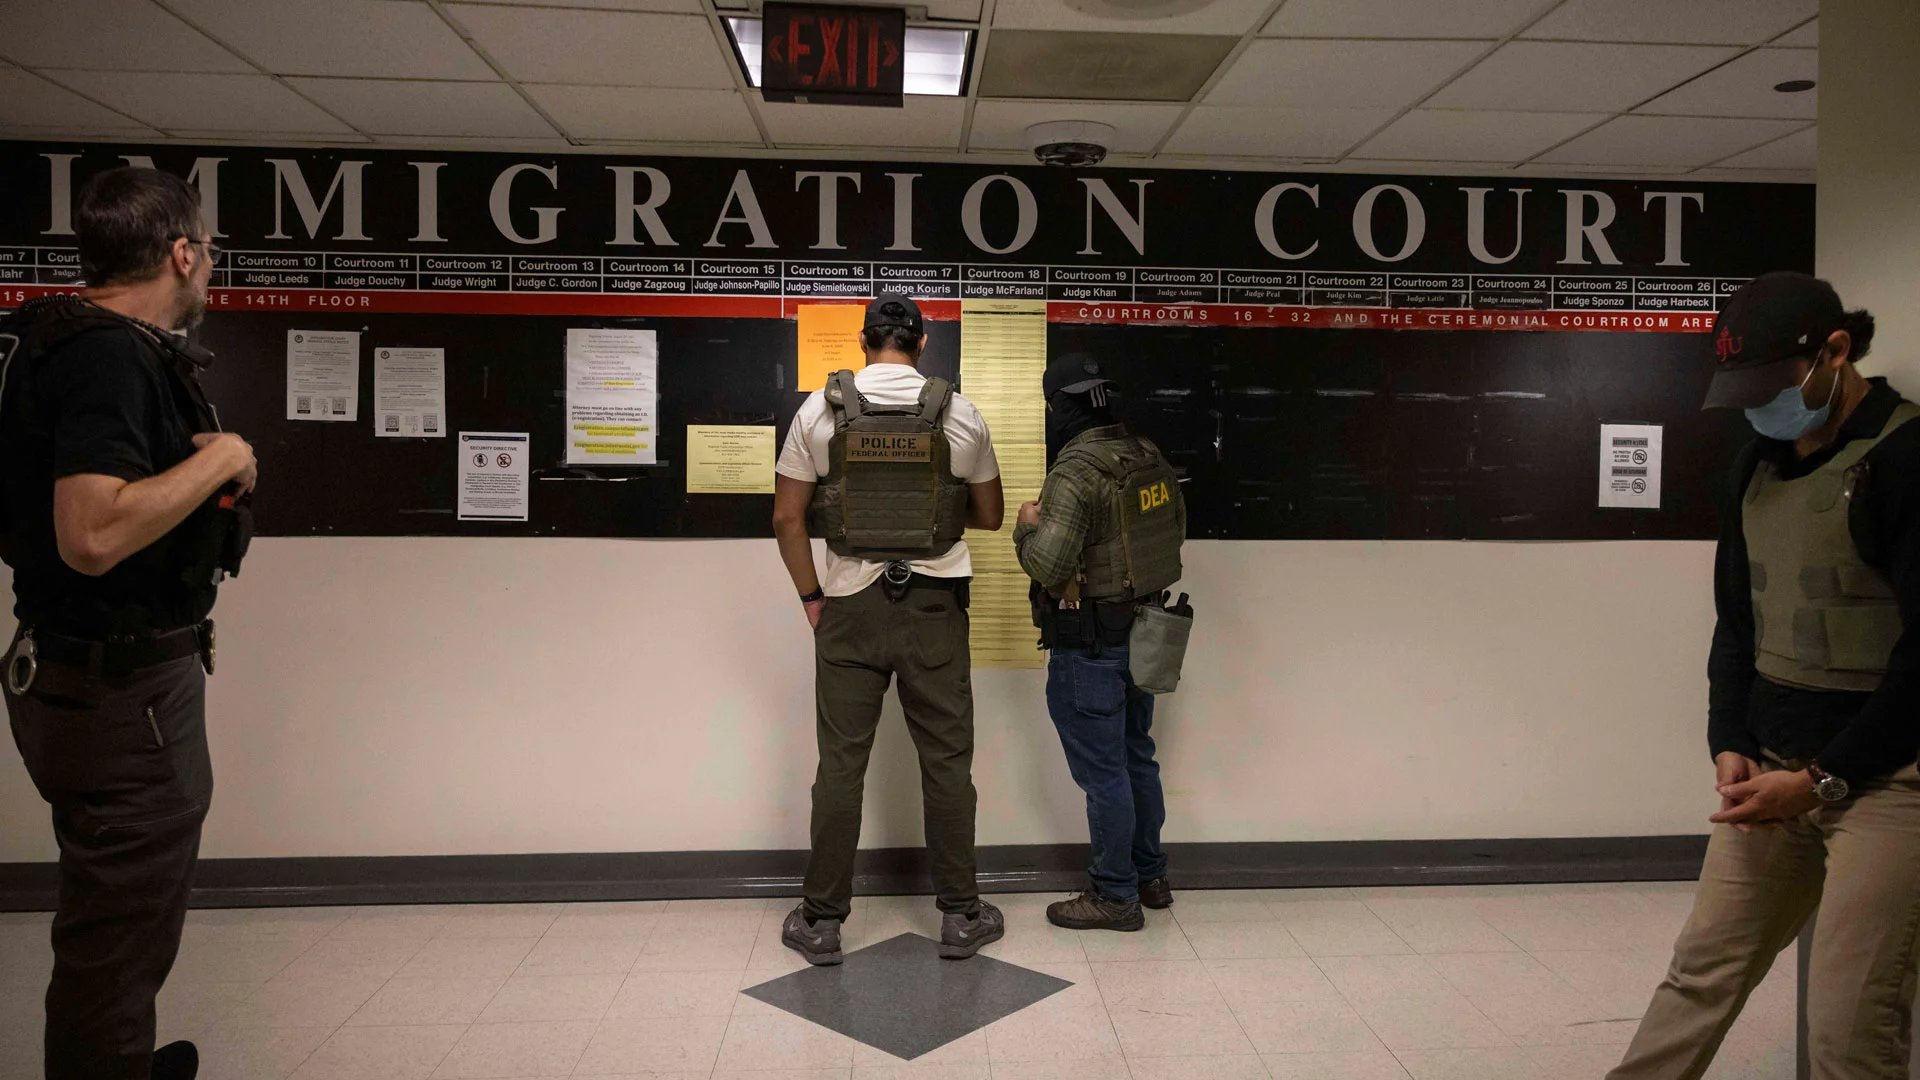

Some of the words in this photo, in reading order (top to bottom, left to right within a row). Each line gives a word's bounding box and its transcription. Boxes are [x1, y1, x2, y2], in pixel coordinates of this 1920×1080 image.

[1253, 182, 1704, 267] COURT
[17, 251, 26, 262] 7
[47, 251, 82, 263] Court
[237, 255, 301, 267] Courtroom
[303, 256, 317, 267] 10
[334, 257, 395, 268] Courtroom
[398, 258, 409, 269] 11
[426, 258, 486, 270] Courtroom
[490, 259, 503, 270] 12
[518, 260, 578, 271] Courtroom
[582, 261, 595, 272] 13
[610, 261, 669, 273] Courtroom
[672, 263, 686, 273] 14
[700, 263, 759, 274] Courtroom
[763, 264, 776, 275] 15
[52, 268, 77, 279] Judge
[790, 265, 848, 276] Courtroom
[852, 266, 865, 276] 16
[879, 266, 937, 277] Courtroom
[941, 267, 952, 278] 17
[967, 268, 1024, 280] Courtroom
[1028, 269, 1040, 279] 18
[1054, 269, 1111, 281] Courtroom
[1114, 271, 1127, 281] 19
[245, 272, 277, 285] Judge
[278, 273, 309, 284] Leeds
[334, 275, 366, 288] Judge
[368, 275, 406, 288] Douchy
[431, 276, 463, 289] Judge
[464, 277, 497, 289] Wright
[1140, 271, 1196, 282] Courtroom
[1199, 272, 1214, 283] 20
[1227, 273, 1282, 284] Courtroom
[1285, 274, 1297, 285] 21
[1308, 275, 1366, 286] Courtroom
[1369, 276, 1384, 287] 22
[1393, 277, 1448, 288] Courtroom
[1451, 278, 1465, 288] 23
[515, 277, 547, 290] Judge
[548, 278, 559, 288] C.
[561, 278, 598, 289] Gordon
[611, 279, 642, 291] Judge
[644, 279, 686, 292] Zagzoug
[694, 280, 719, 292] Judge
[719, 280, 780, 293] Johnson-Papillo
[786, 282, 812, 294] Judge
[812, 282, 870, 294] Siemietkowski
[882, 283, 915, 295] Judge
[917, 284, 951, 295] Kouris
[1476, 278, 1530, 289] Courtroom
[1533, 279, 1547, 289] 24
[1558, 279, 1612, 290] Courtroom
[1615, 280, 1628, 290] 25
[1637, 280, 1693, 291] Courtroom
[1697, 281, 1711, 292] 26
[3, 290, 26, 302] 15
[964, 285, 994, 297] Judge
[995, 285, 1044, 296] McFarland
[1062, 287, 1092, 299] Judge
[1093, 287, 1117, 297] Khan
[1157, 289, 1178, 298] Judge
[1178, 289, 1203, 298] Adams
[1326, 292, 1347, 300] Judge
[1347, 292, 1362, 300] Kim
[204, 293, 230, 305] HE
[245, 294, 289, 306] 14TH
[308, 295, 370, 307] FLOOR
[1562, 296, 1590, 308] Judge
[1591, 296, 1625, 308] Sponzo
[1638, 297, 1669, 309] Judge
[1670, 297, 1710, 308] Harbeck
[1079, 307, 1209, 321] COURTROOMS
[1233, 311, 1253, 322] 16
[1290, 311, 1311, 323] 32
[1333, 312, 1369, 324] AND
[1380, 313, 1413, 325] THE
[1428, 313, 1549, 326] CEREMONIAL
[1560, 315, 1670, 327] COURTROOM
[1681, 316, 1713, 328] ARE
[861, 437, 917, 449] POLICE
[892, 450, 926, 458] OFFICER
[1140, 482, 1170, 512] DEA
